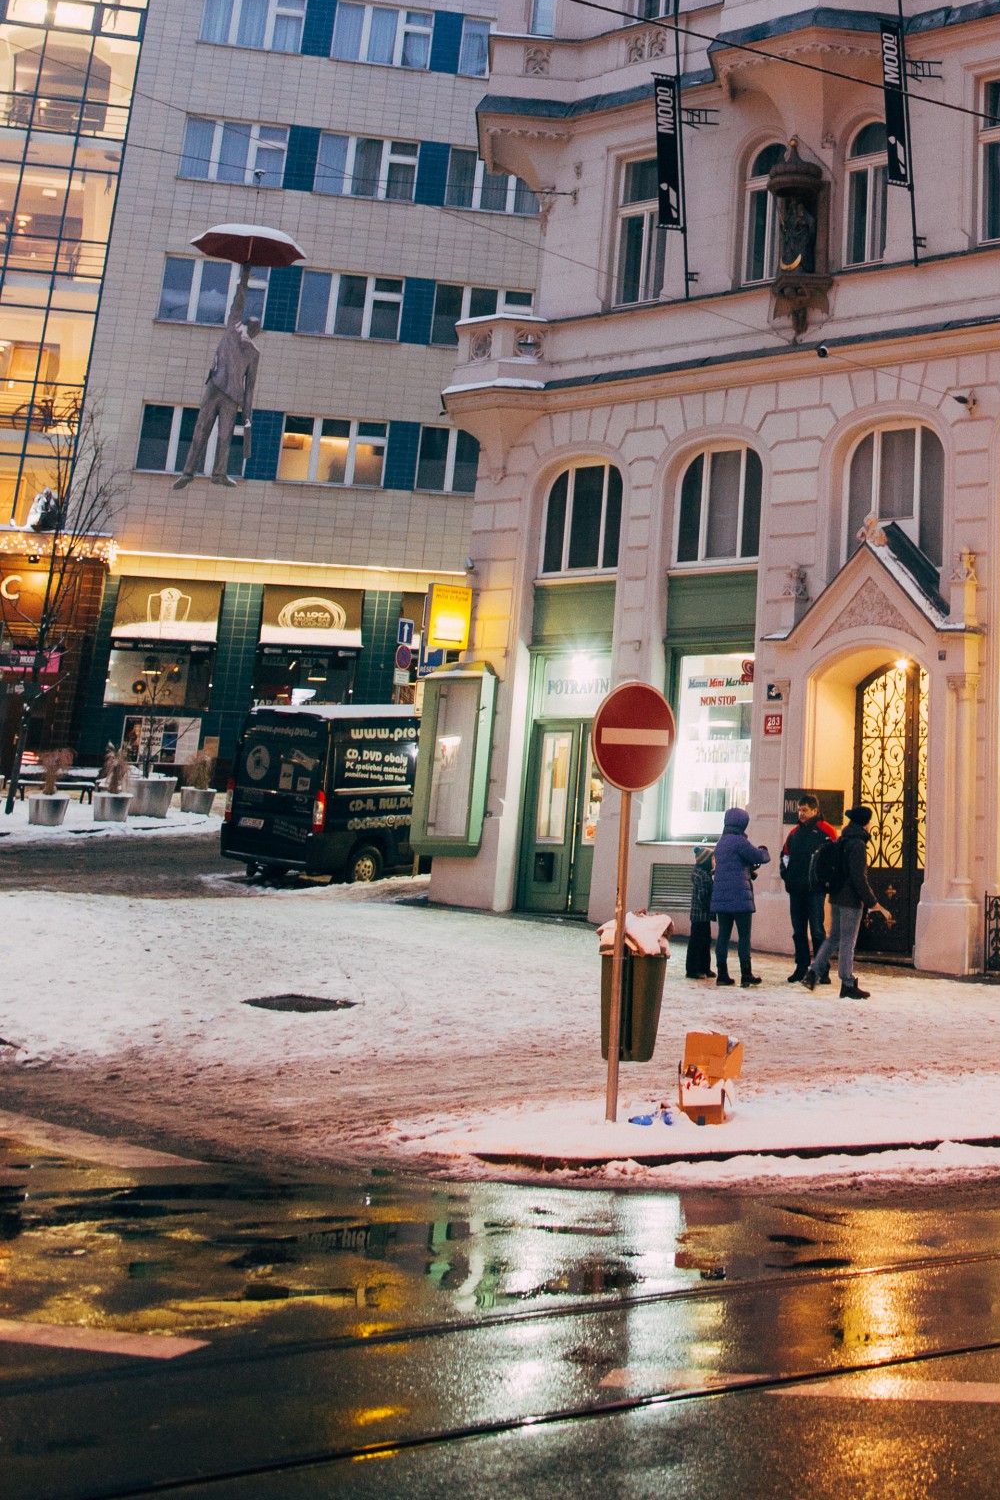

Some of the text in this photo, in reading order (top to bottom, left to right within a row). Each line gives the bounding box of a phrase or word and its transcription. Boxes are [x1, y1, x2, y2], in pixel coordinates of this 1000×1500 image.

[709, 678, 725, 687] Mini
[700, 695, 737, 706] NON STOP
[346, 748, 408, 767] CD, DVD obaly
[345, 761, 354, 769] PC
